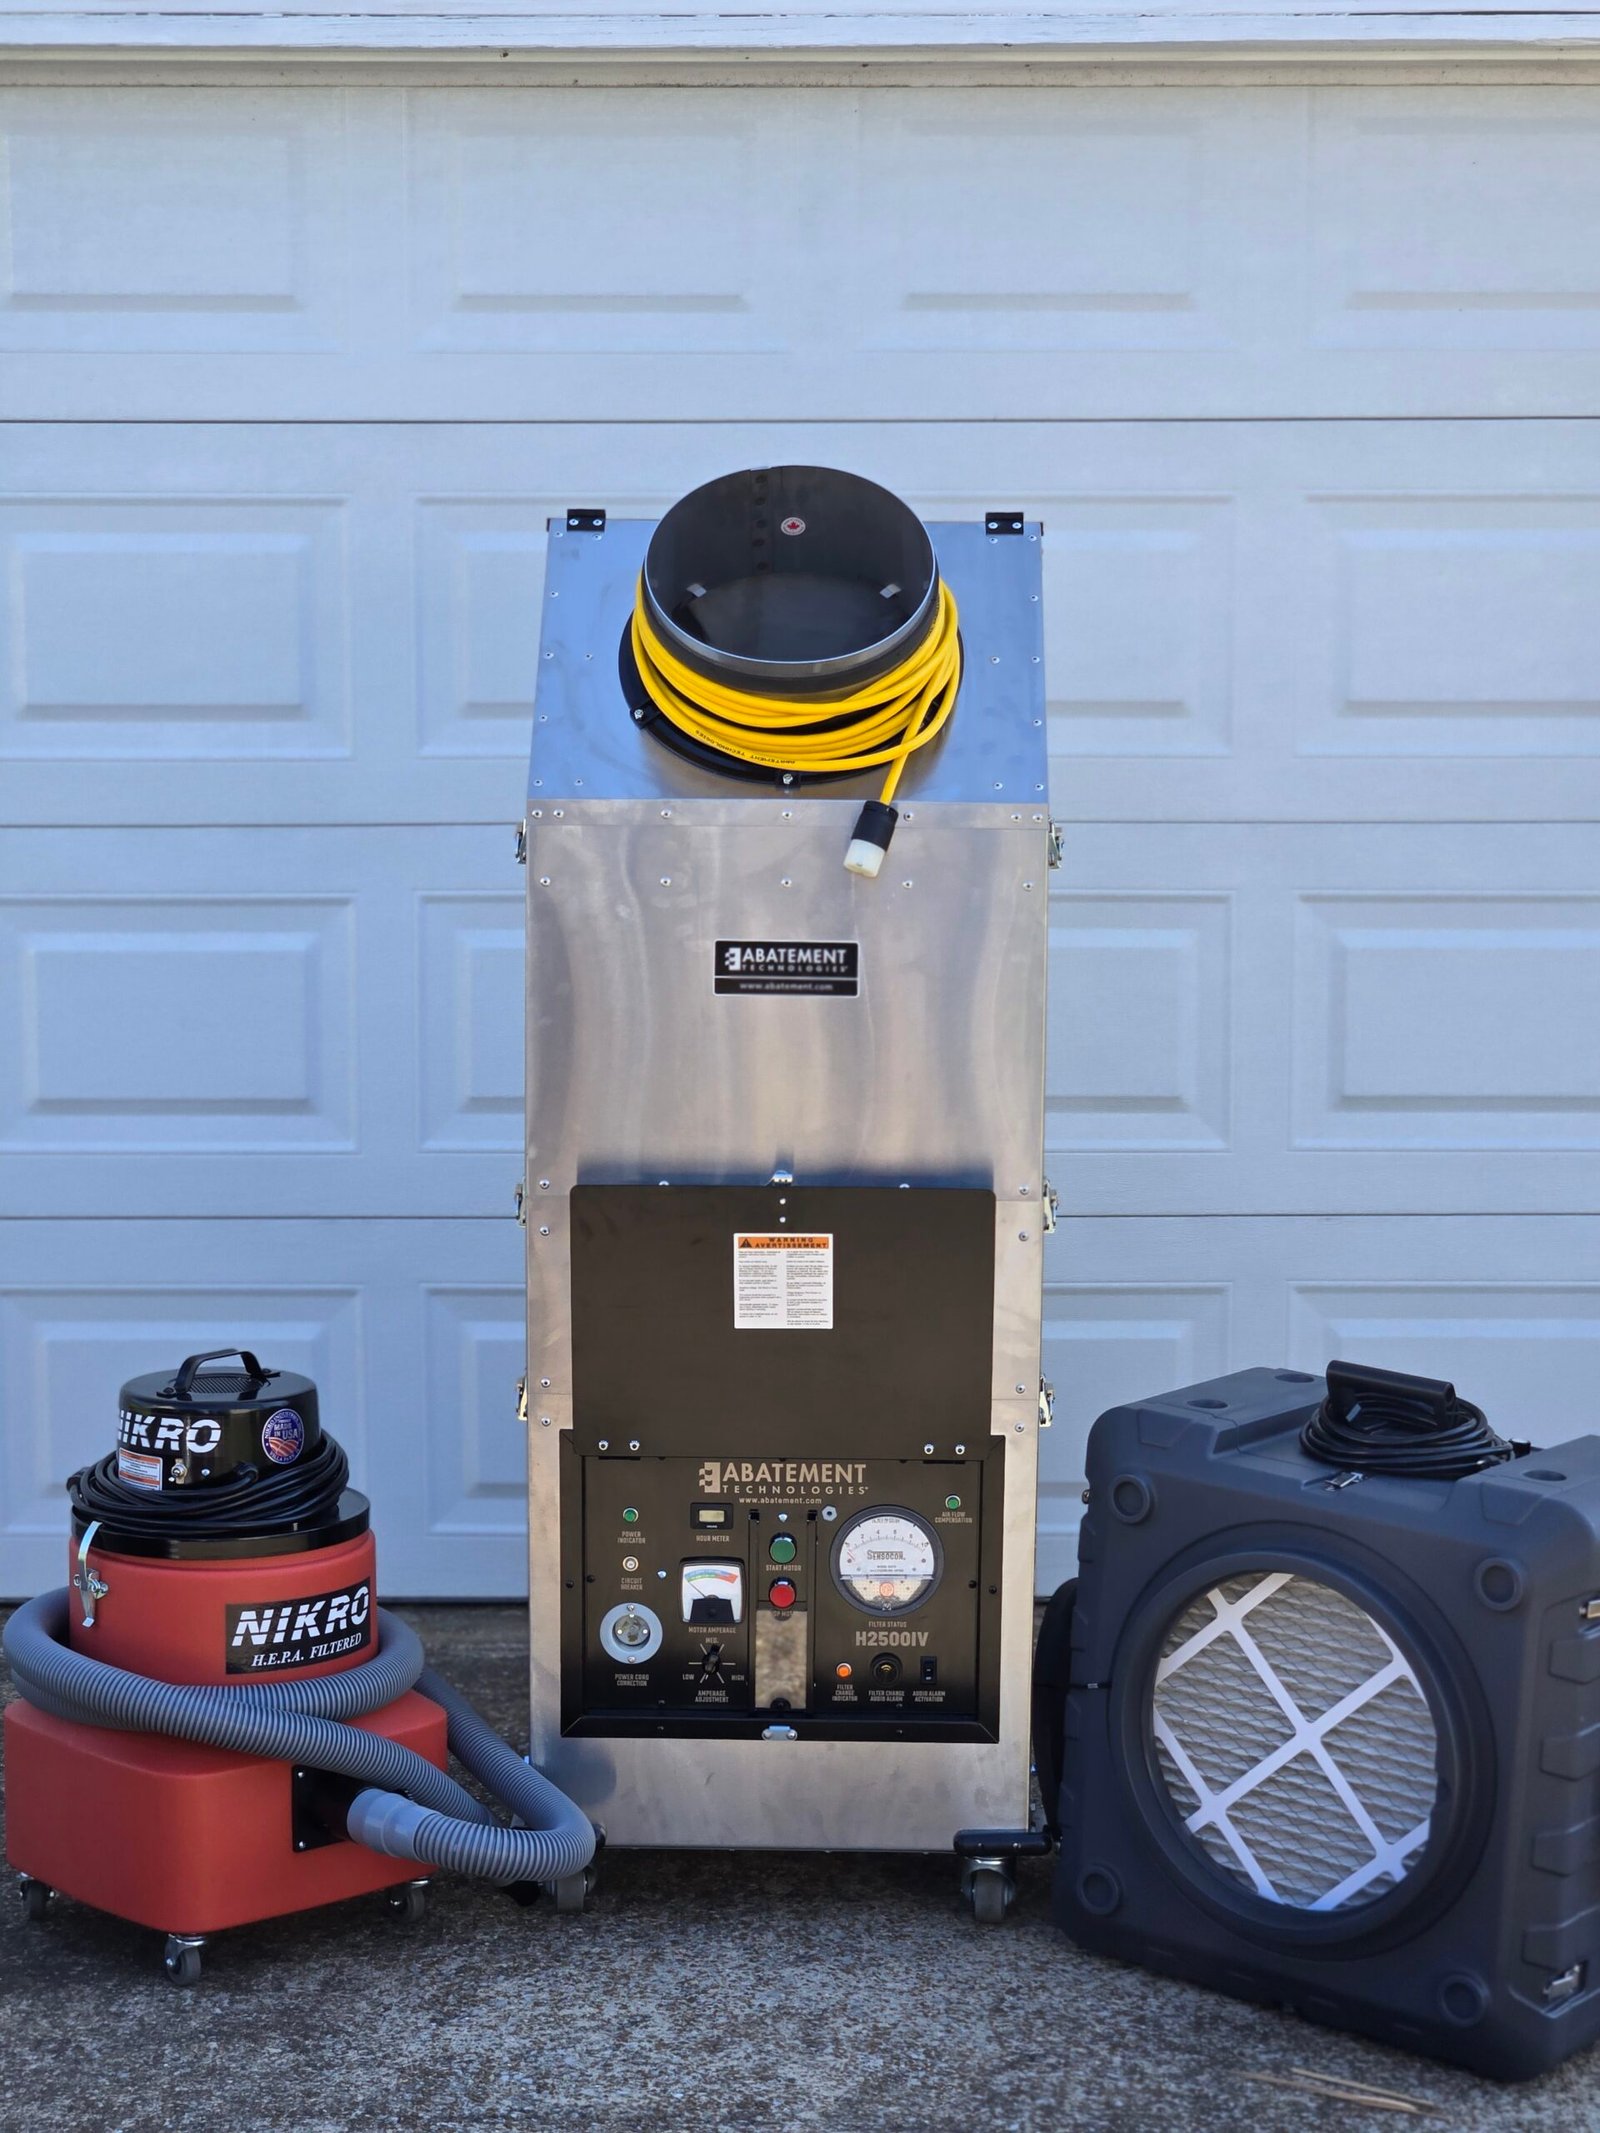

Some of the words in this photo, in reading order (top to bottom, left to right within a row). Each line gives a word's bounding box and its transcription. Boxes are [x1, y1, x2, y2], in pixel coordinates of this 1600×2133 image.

[742, 947, 847, 964] ABATEMENT
[742, 964, 848, 973] TECHNOLOGIES
[739, 982, 834, 991] www.abatement.com
[282, 1428, 299, 1440] USA
[722, 1462, 867, 1484] ABATEMENT
[722, 1484, 866, 1495] TECHNOLOGIES
[738, 1496, 822, 1505] www.abatement.com
[765, 1564, 782, 1572] START
[782, 1564, 802, 1572] MOTOR
[231, 1585, 369, 1647] NIKRO
[855, 1630, 929, 1647] H2500IV
[250, 1649, 304, 1667] H.E.P.A.
[309, 1632, 362, 1659] FILTERED
